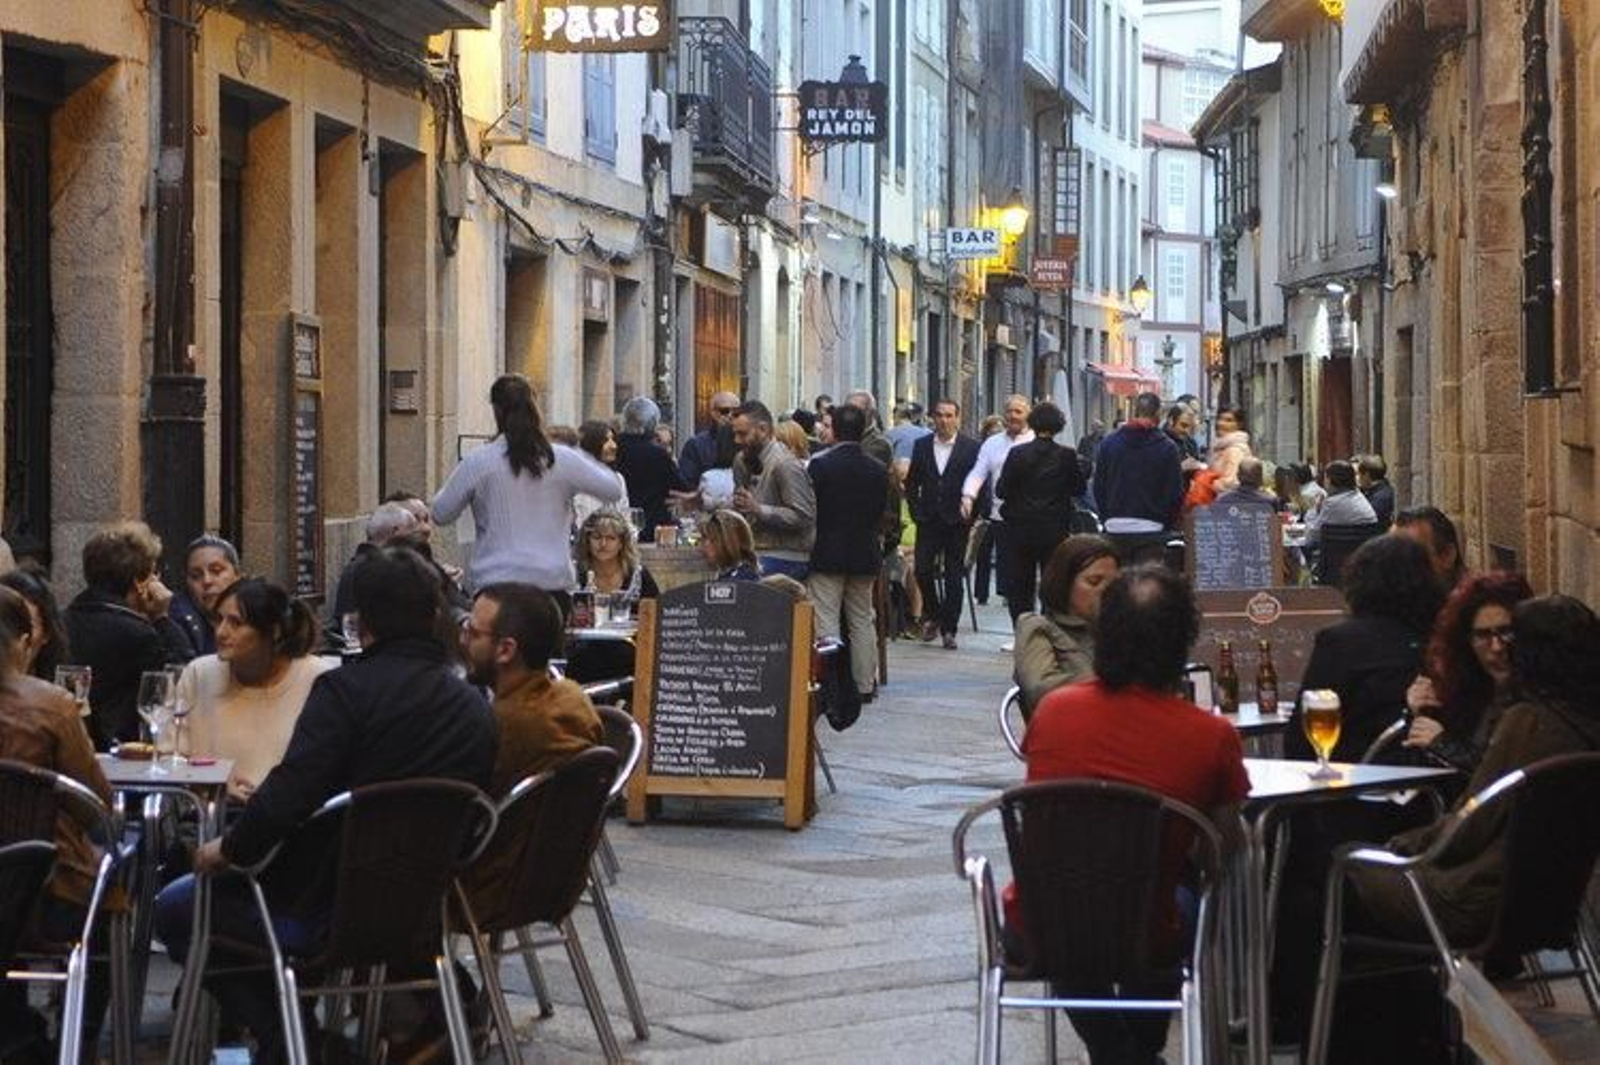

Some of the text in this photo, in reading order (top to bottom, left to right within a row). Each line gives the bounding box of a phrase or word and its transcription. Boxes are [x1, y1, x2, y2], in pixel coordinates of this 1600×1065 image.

[543, 5, 660, 43] PARIS
[815, 88, 871, 106] BAR
[807, 108, 875, 121] REY DEL
[952, 231, 995, 243] BAR
[709, 587, 731, 598] HOY
